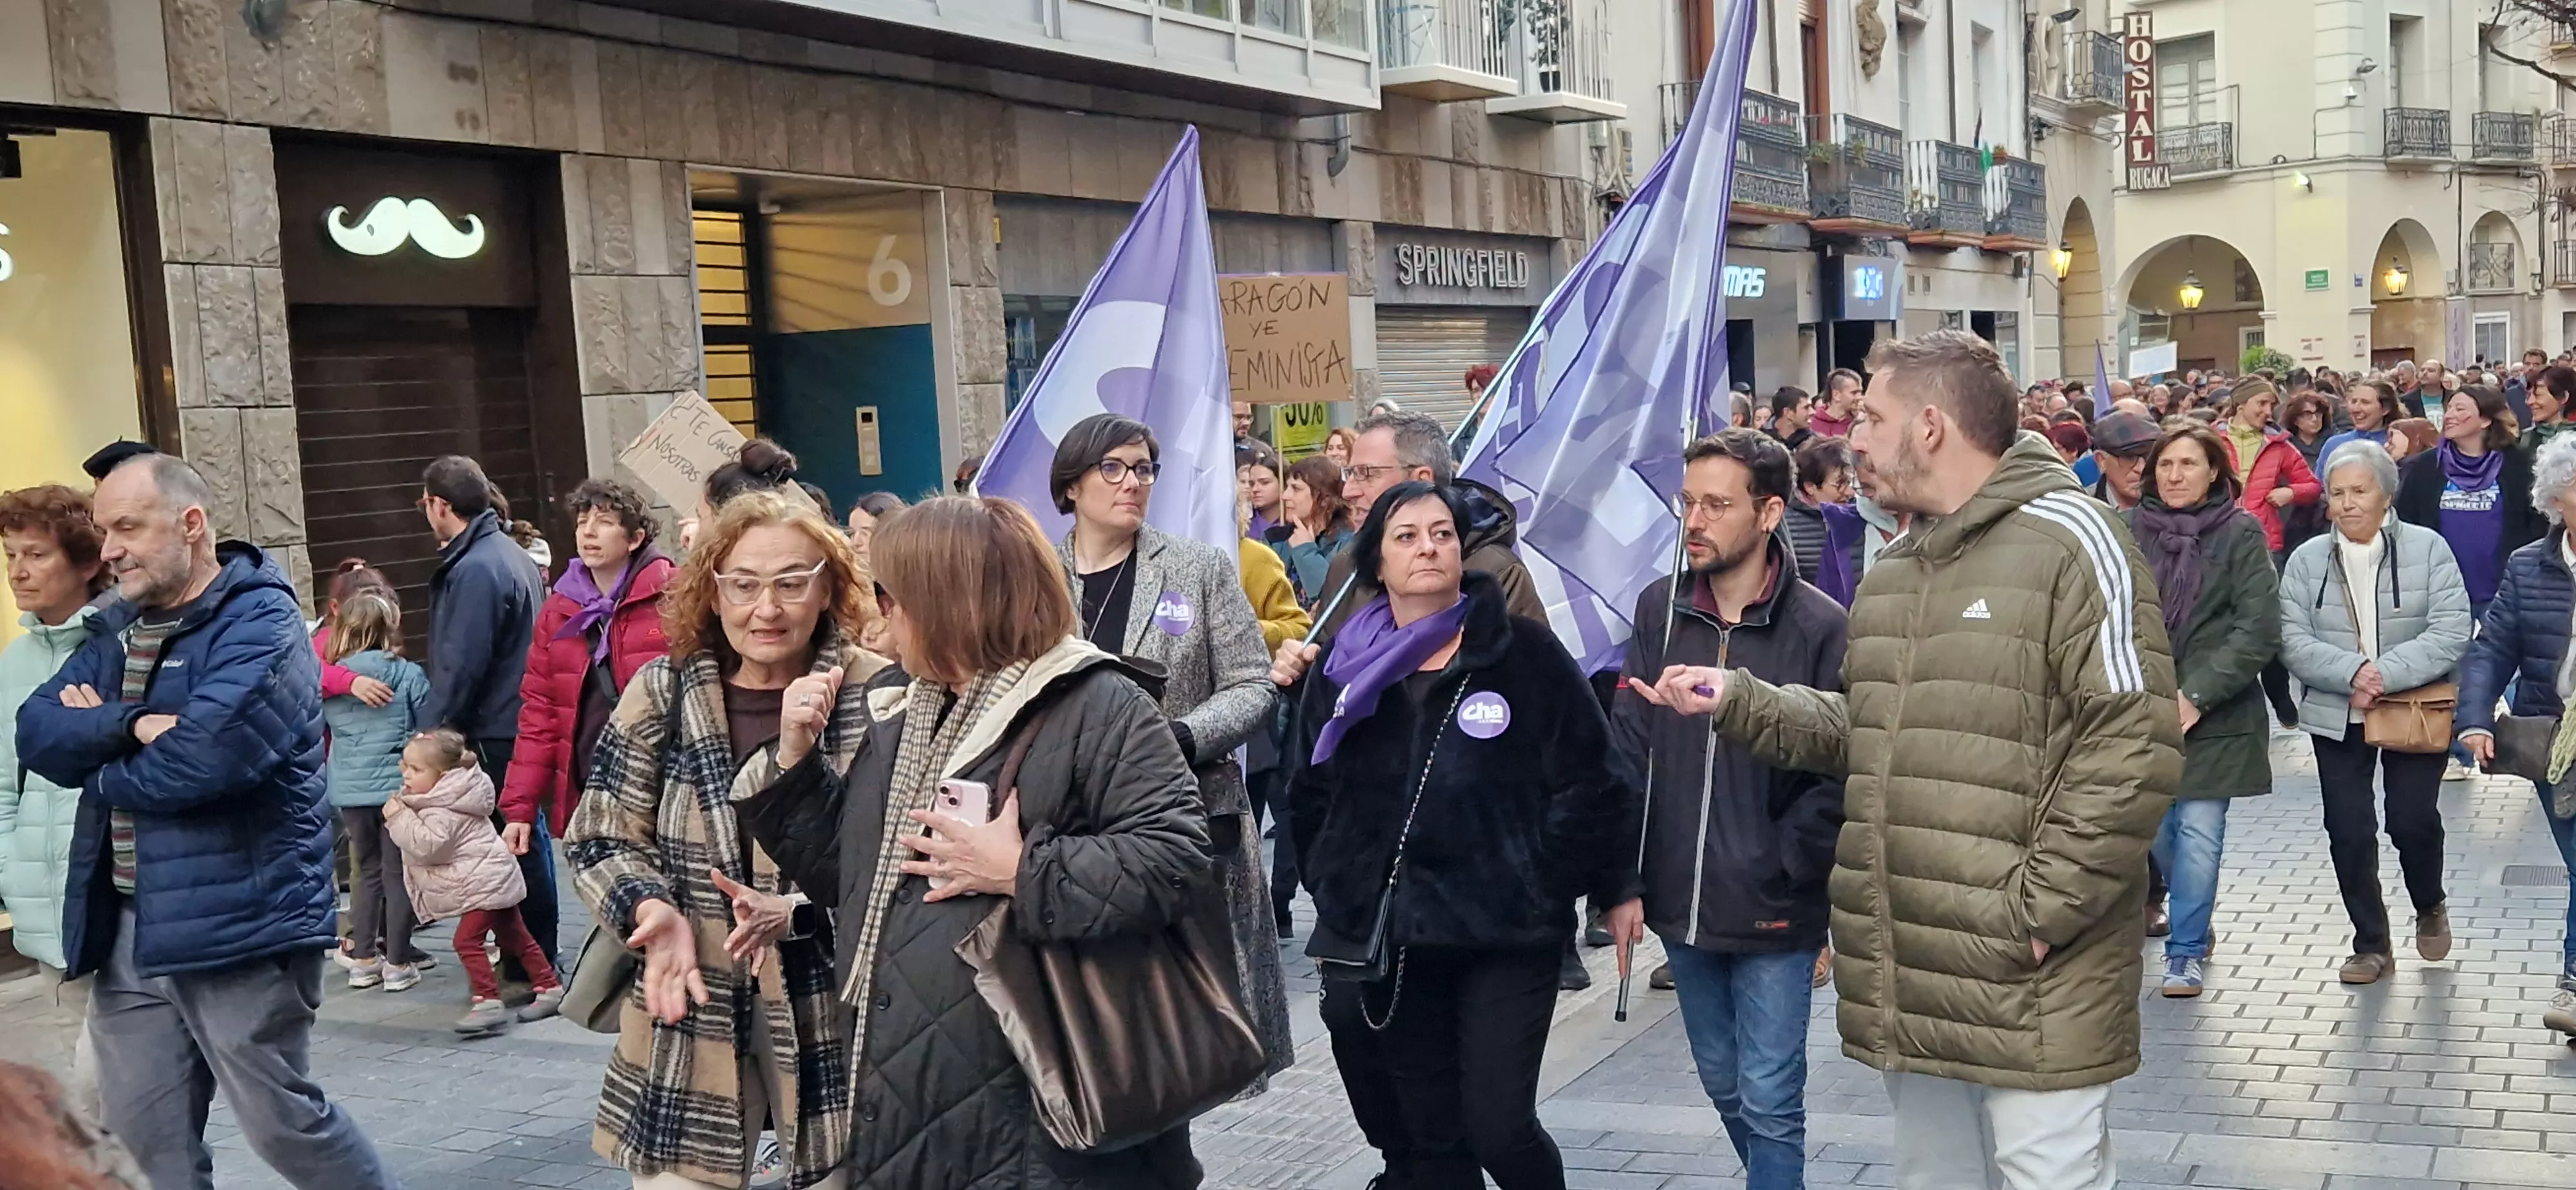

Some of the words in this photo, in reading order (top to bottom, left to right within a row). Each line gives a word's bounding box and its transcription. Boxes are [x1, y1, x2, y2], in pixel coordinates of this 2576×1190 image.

[2128, 15, 2153, 162] HOSTAL
[2130, 165, 2171, 190] RUGACA
[868, 235, 911, 307] 6
[1397, 243, 1530, 288] SPRINGFIELD
[1723, 265, 1766, 297] MAS
[1249, 319, 1278, 339] YE
[647, 433, 701, 482] NOSOTRAS
[1155, 600, 1189, 618] cha
[1462, 701, 1503, 720] cha
